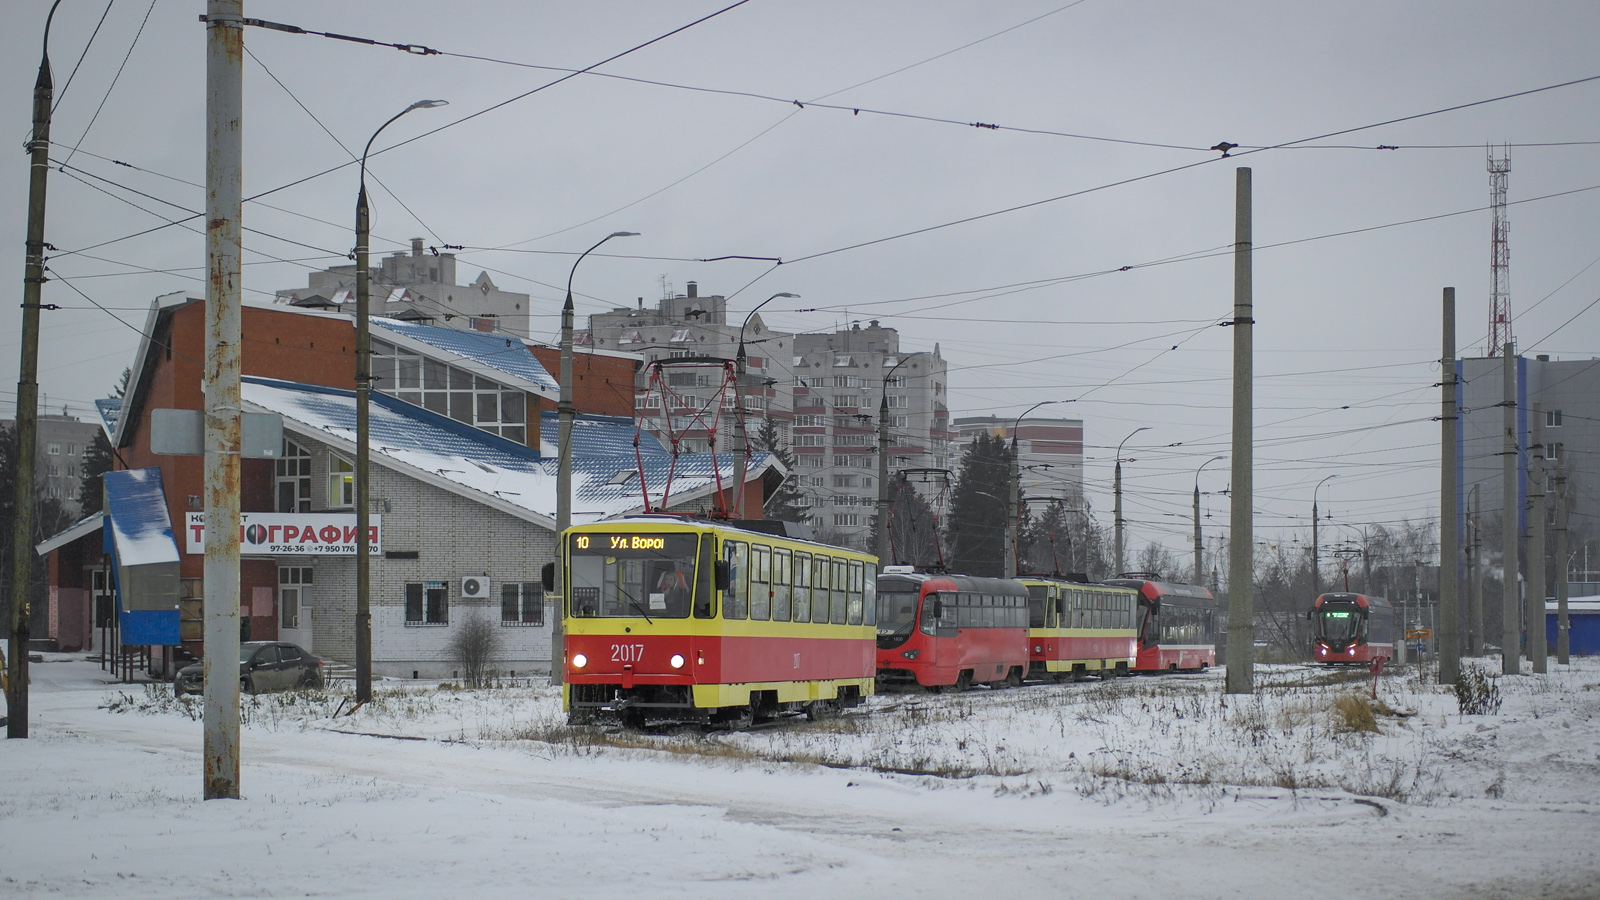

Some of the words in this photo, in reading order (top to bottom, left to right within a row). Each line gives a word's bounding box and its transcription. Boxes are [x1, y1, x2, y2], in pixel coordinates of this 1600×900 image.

[190, 524, 378, 545] ТОГРАФИЯ
[576, 536, 590, 549] 10
[610, 536, 629, 549] Ул.
[25, 602, 31, 615] 5
[611, 644, 644, 661] 2017
